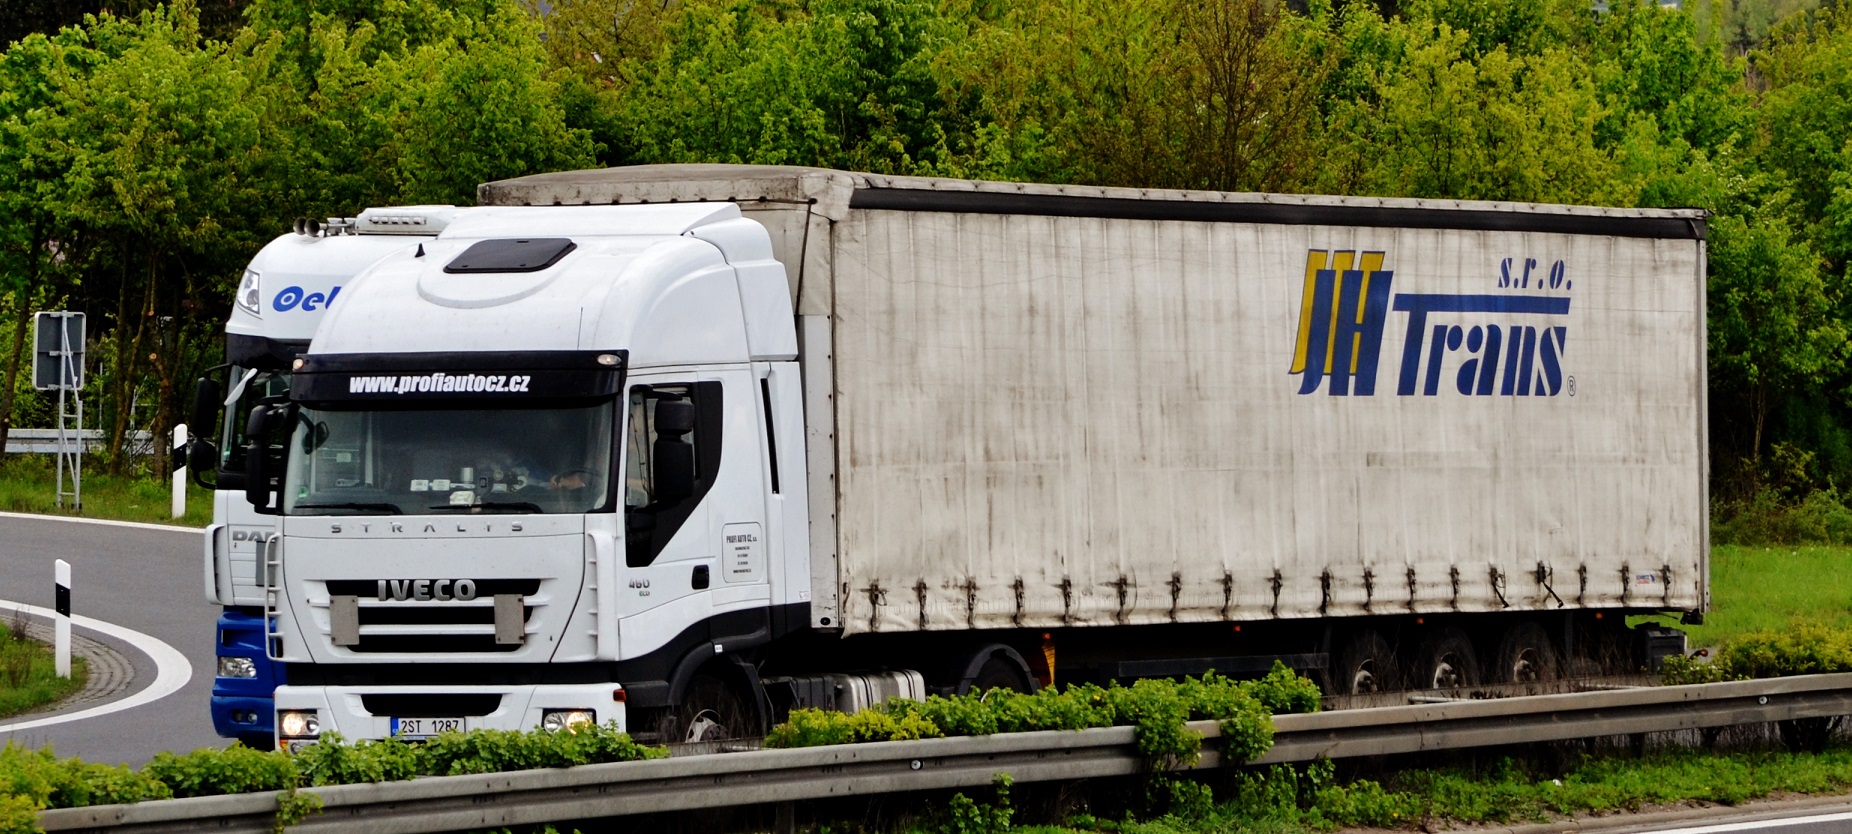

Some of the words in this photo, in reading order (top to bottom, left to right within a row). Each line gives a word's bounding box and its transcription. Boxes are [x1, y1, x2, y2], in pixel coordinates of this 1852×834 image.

[1498, 257, 1572, 291] s.r.o.
[1392, 293, 1572, 397] Trans
[349, 372, 531, 395] www.profiautocz.cz
[330, 520, 524, 534] STRALIS
[376, 578, 477, 602] IVECO
[401, 720, 422, 733] 2ST
[432, 720, 459, 733] 1287
